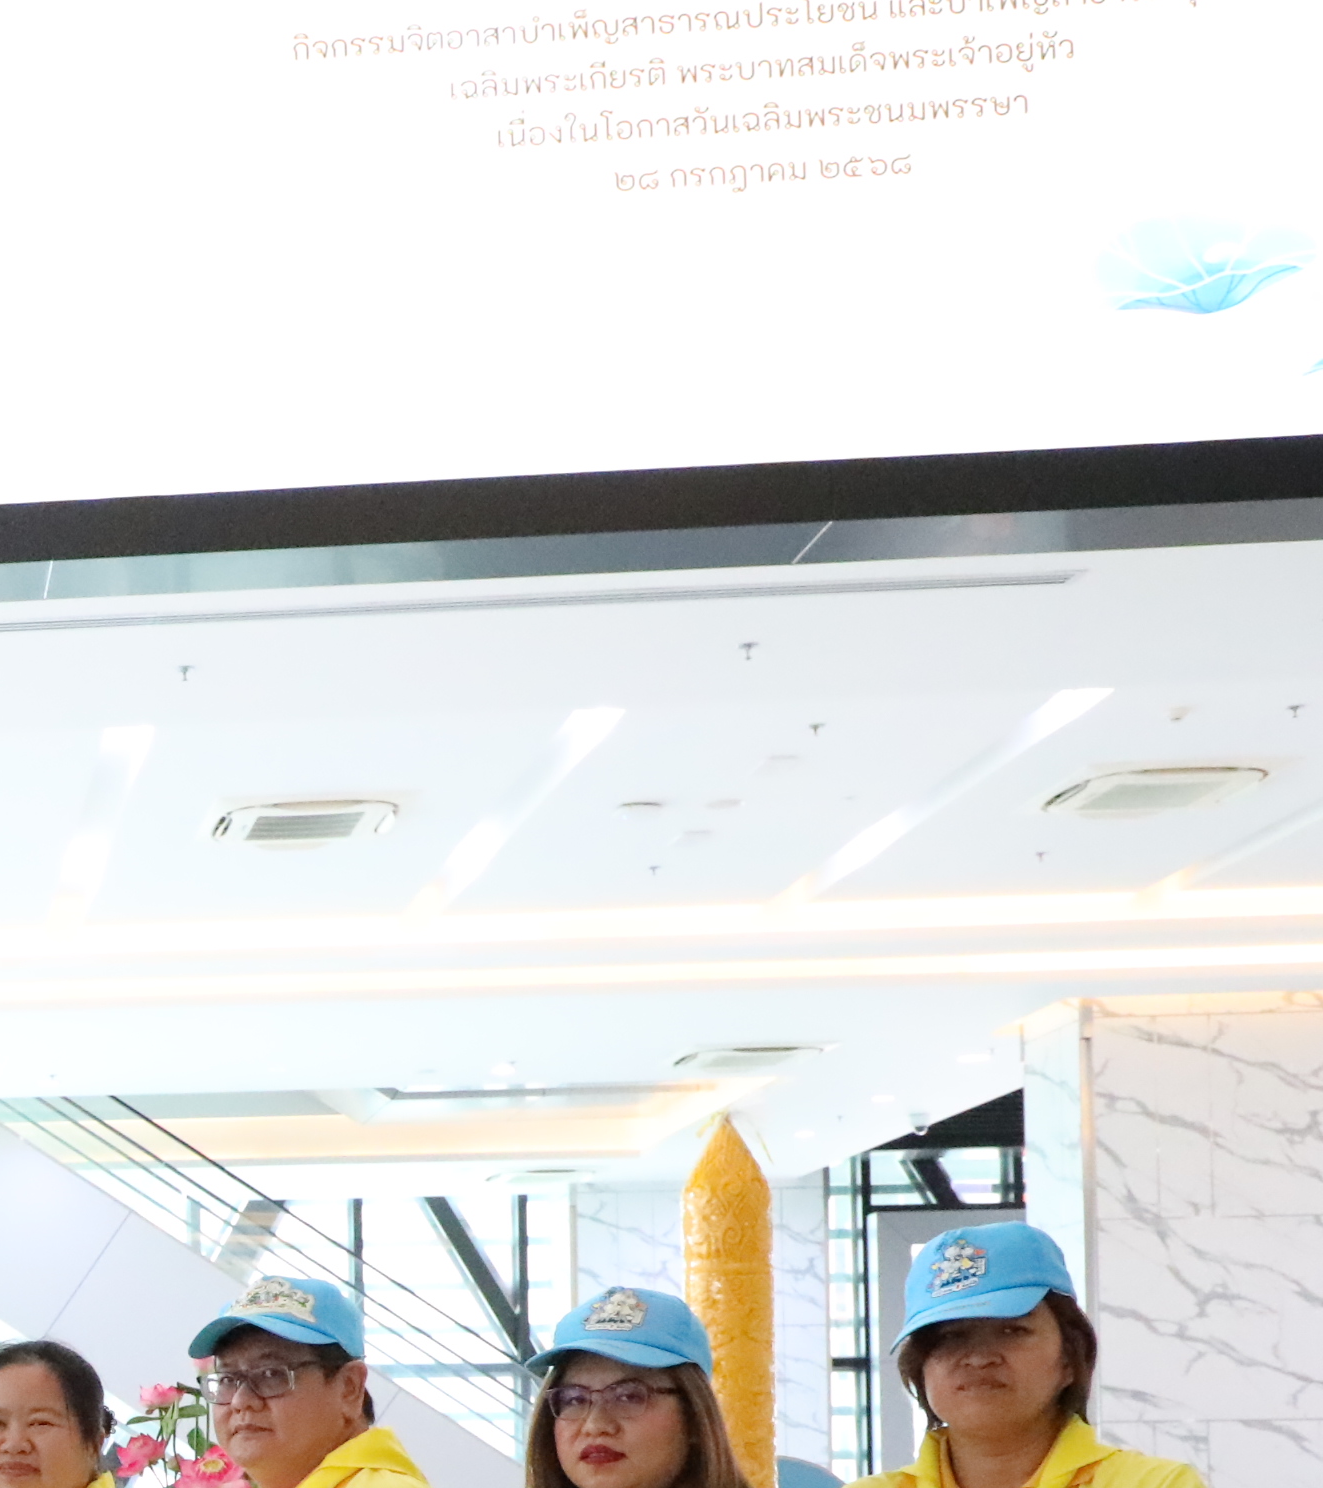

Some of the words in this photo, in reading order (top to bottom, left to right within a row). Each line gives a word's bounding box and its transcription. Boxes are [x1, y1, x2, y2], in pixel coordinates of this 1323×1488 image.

[291, 0, 880, 61] กิจกรรมจิตอาสาบำเพ็ญสาธารณประโยชน
[450, 57, 667, 99] เฉลิมพระเกียรติ
[676, 31, 1075, 85] พระบาทสมเด็จพระเจ้าอยู่หัว
[496, 94, 1030, 148] เนื่องในโอกาสวันเฉลิมพระชนมพรรษา
[614, 169, 660, 192] ๒๘
[669, 161, 808, 194] กรกฎาคม
[818, 153, 912, 180] ๒๕๖๘
